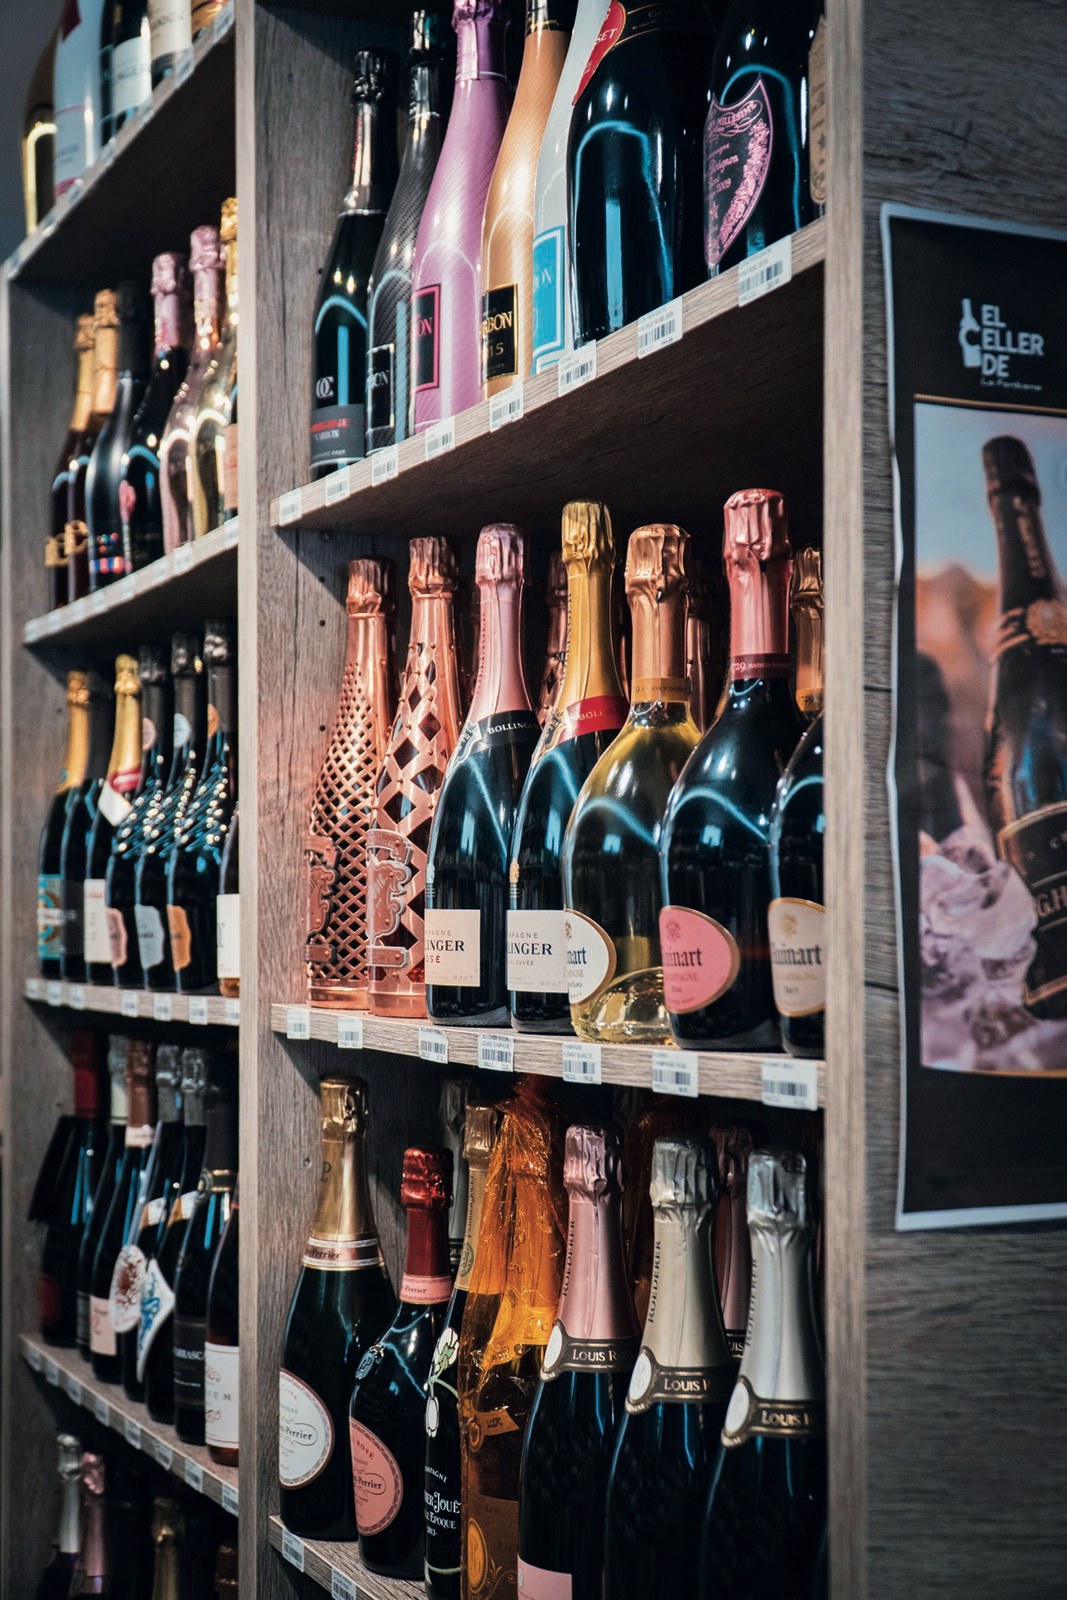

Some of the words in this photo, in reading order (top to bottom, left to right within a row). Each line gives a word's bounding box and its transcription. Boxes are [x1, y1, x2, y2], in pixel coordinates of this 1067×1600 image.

[981, 304, 1007, 328] EL
[958, 326, 1045, 356] CELLER
[981, 353, 1010, 378] DE
[572, 1349, 606, 1362] LOUIS
[663, 1377, 700, 1392] LOUIS
[761, 1410, 801, 1426] LOUIS
